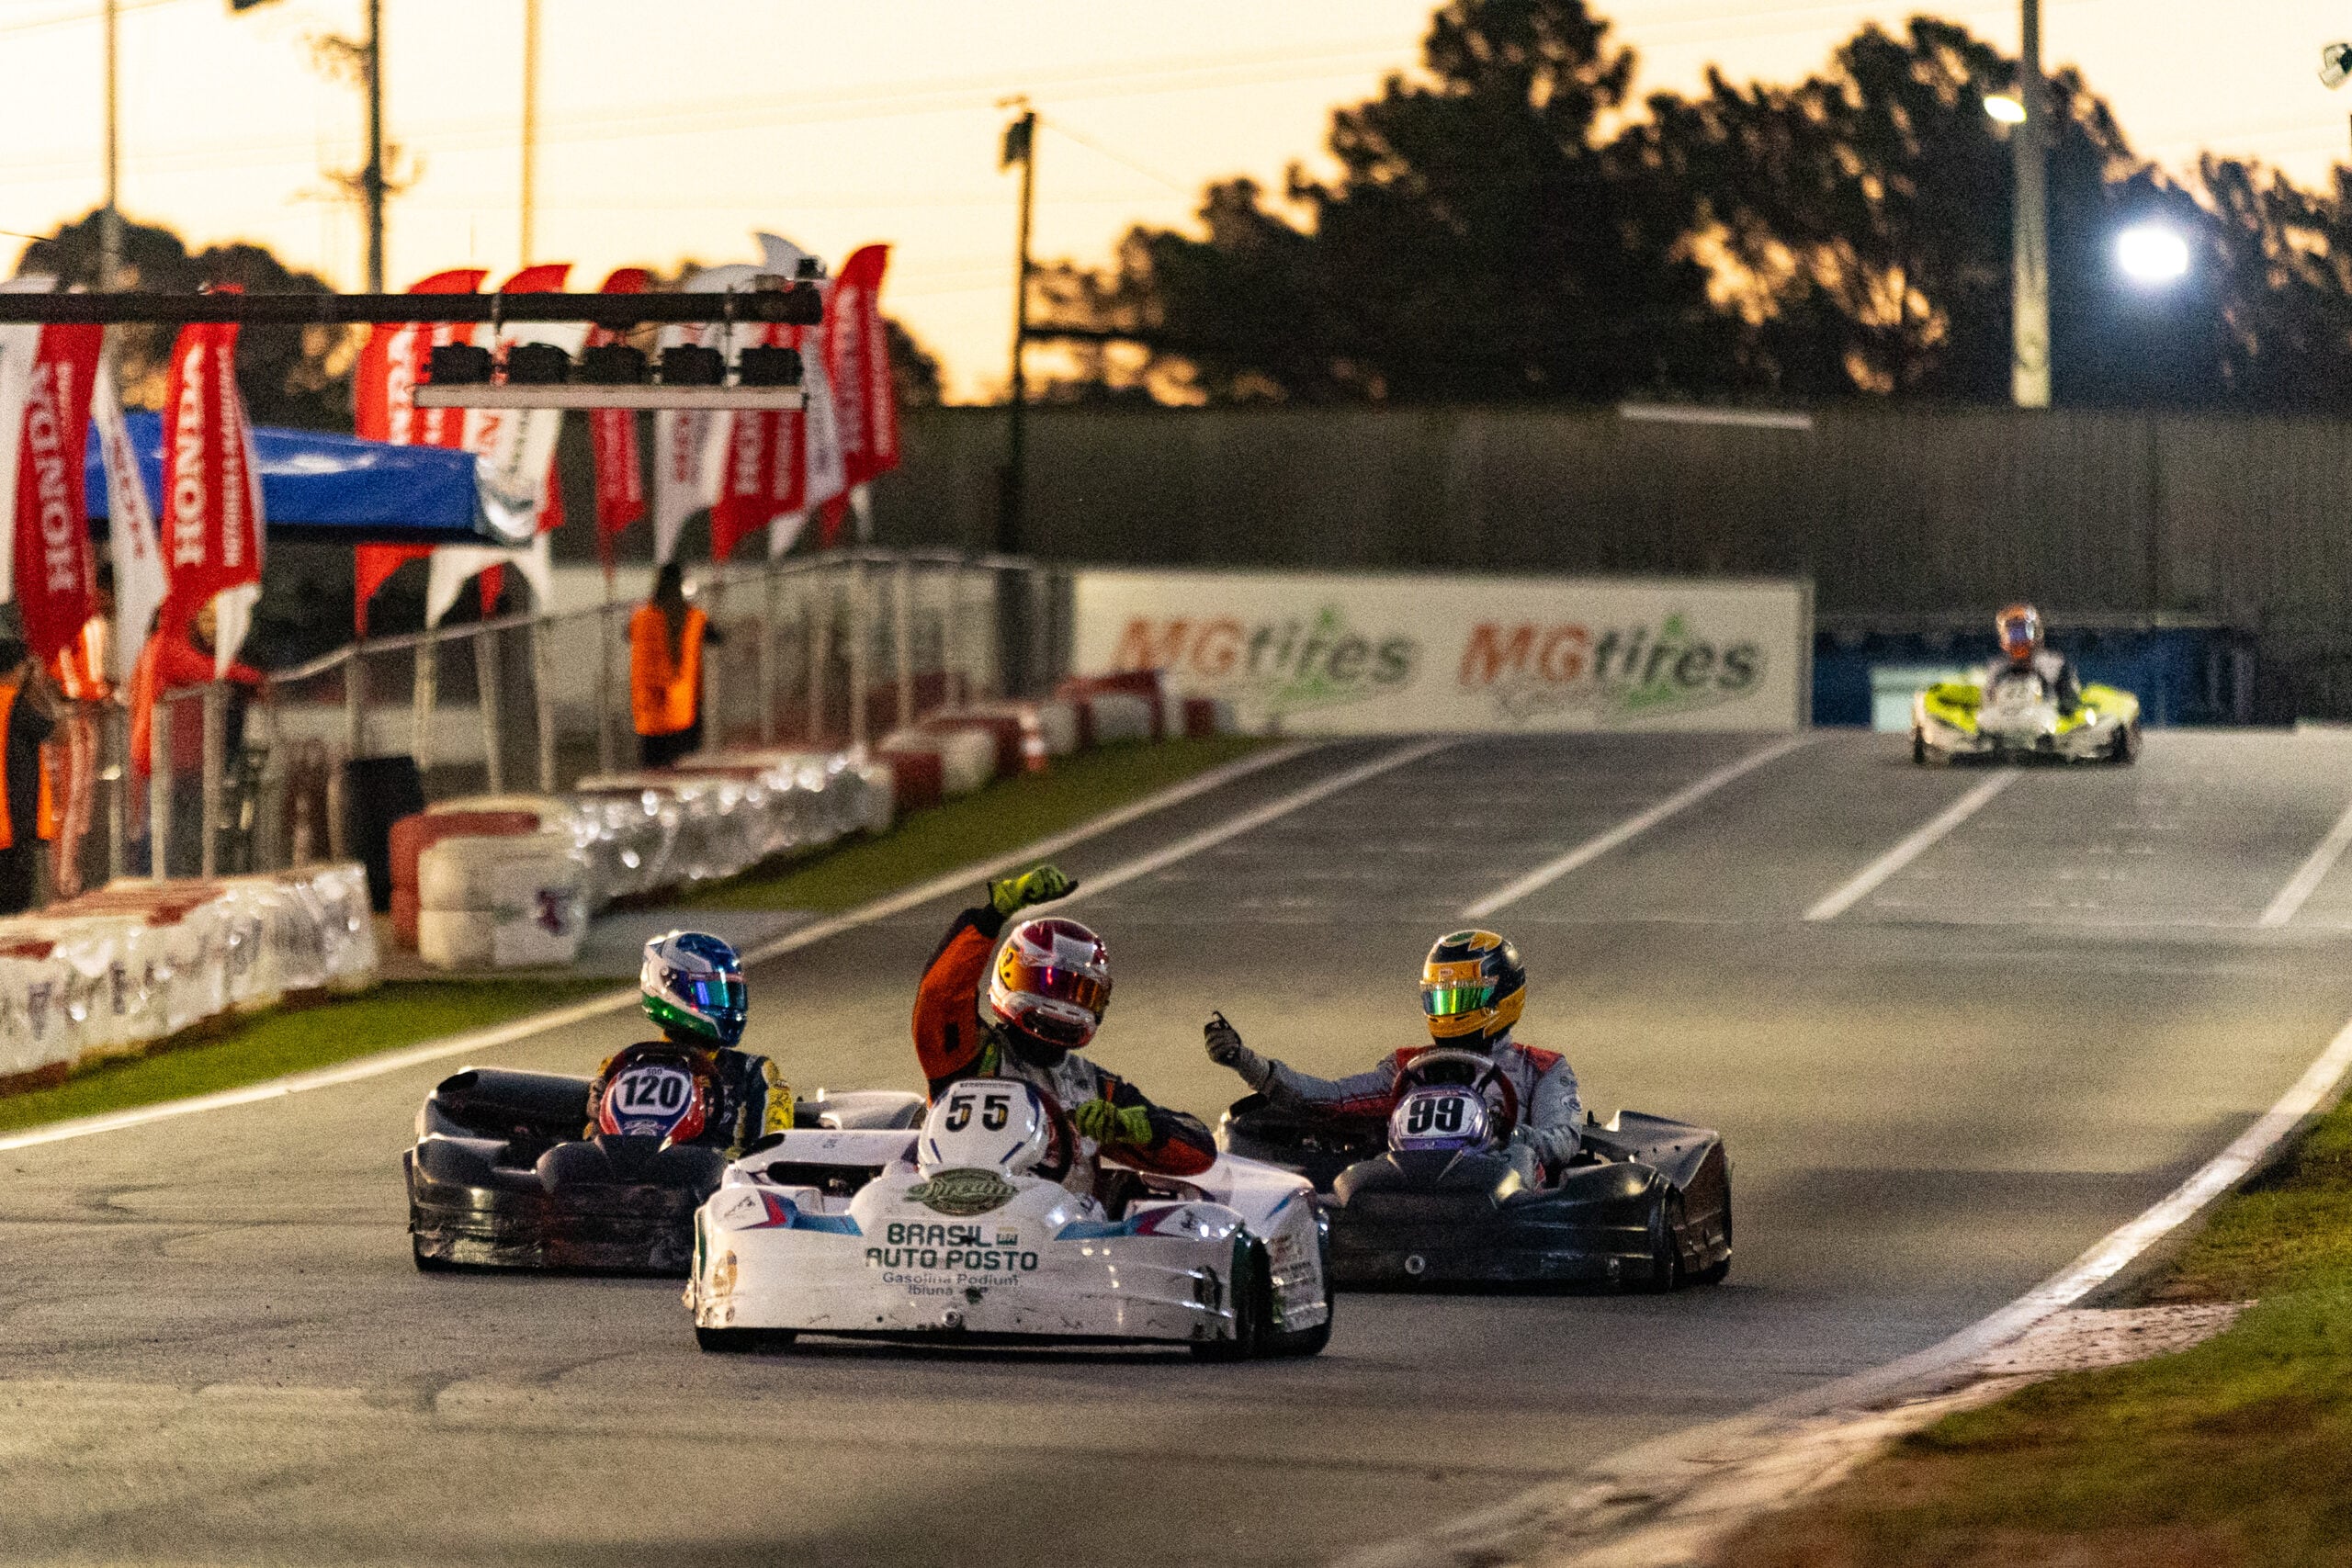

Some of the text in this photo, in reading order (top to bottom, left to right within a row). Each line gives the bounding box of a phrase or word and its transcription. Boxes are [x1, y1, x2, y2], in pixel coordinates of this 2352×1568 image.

[174, 342, 207, 567] HONDA
[29, 361, 76, 592] HONDA
[1107, 614, 1761, 690] MGtires MGtires
[621, 1075, 684, 1110] 120
[945, 1094, 1012, 1133] 55
[1407, 1097, 1465, 1134] 99
[887, 1223, 993, 1248] BRASIL
[865, 1247, 1039, 1271] AUTO POSTO
[882, 1271, 1019, 1286] Gasolina Podium
